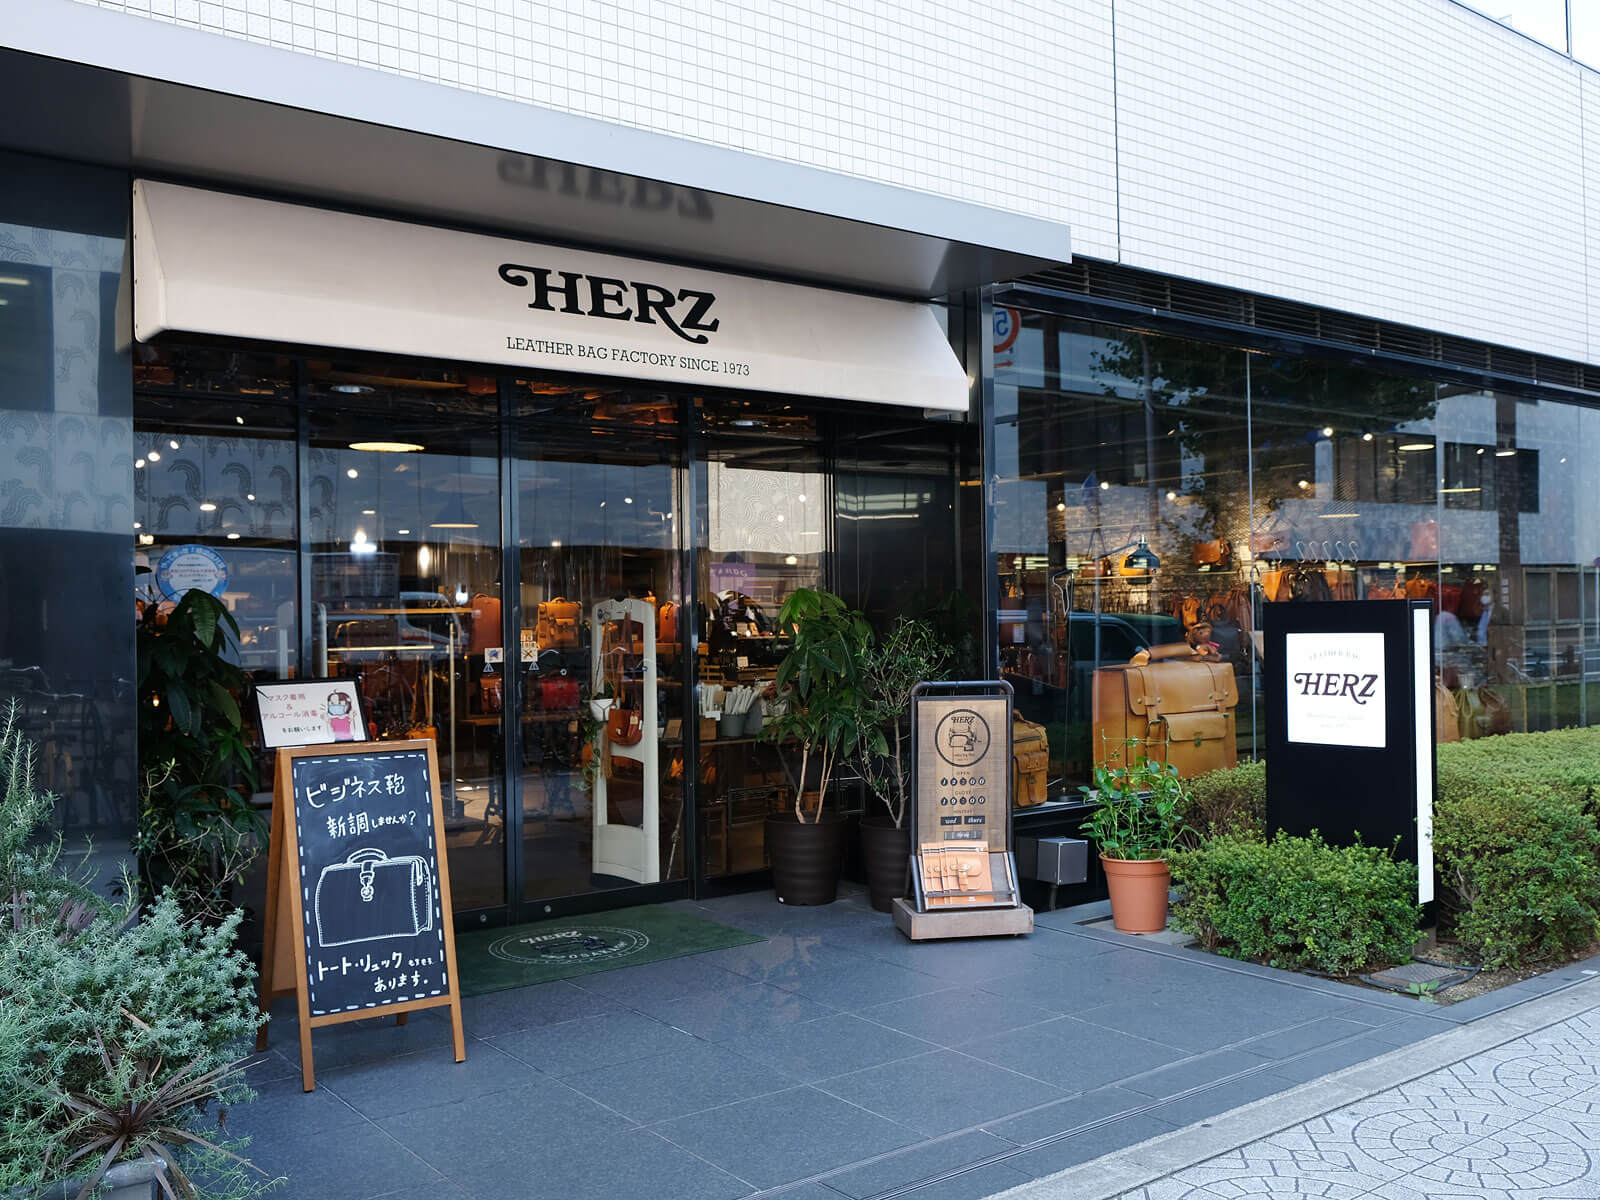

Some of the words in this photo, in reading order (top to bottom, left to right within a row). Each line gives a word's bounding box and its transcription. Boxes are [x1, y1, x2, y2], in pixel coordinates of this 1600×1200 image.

[498, 263, 720, 345] HERZ
[507, 336, 575, 356] LEATHER
[577, 346, 608, 360] BAG
[611, 348, 676, 368] FACTORY
[679, 356, 719, 373] SINCE
[722, 361, 750, 376] 1973
[1294, 672, 1378, 705] HERZ
[306, 772, 405, 808] ビジネス鞄
